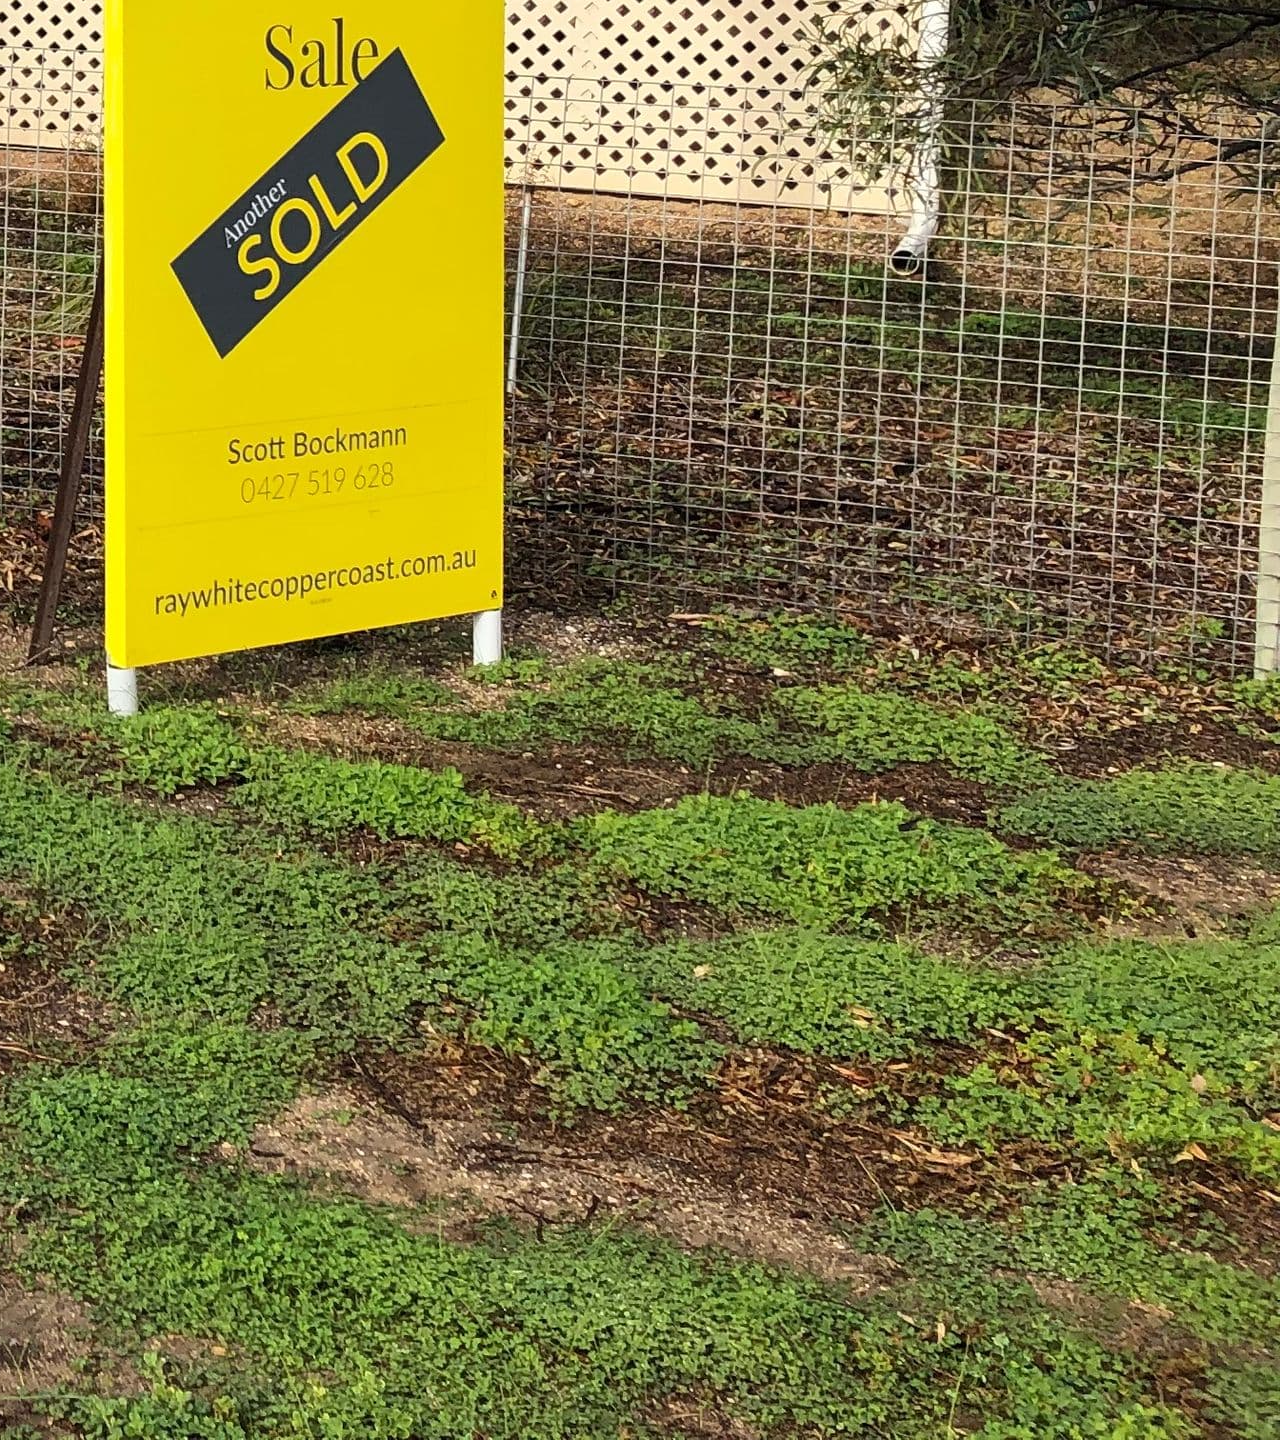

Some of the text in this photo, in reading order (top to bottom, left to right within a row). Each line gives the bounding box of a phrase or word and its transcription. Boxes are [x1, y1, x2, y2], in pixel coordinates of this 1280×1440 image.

[265, 17, 379, 90] Sale
[224, 178, 287, 248] Another
[237, 131, 389, 300] SOLD
[228, 427, 407, 464] Scott Bockmann
[241, 461, 394, 503] 0427 519 628
[155, 549, 477, 617] raywhitecoppercoast.com.au
